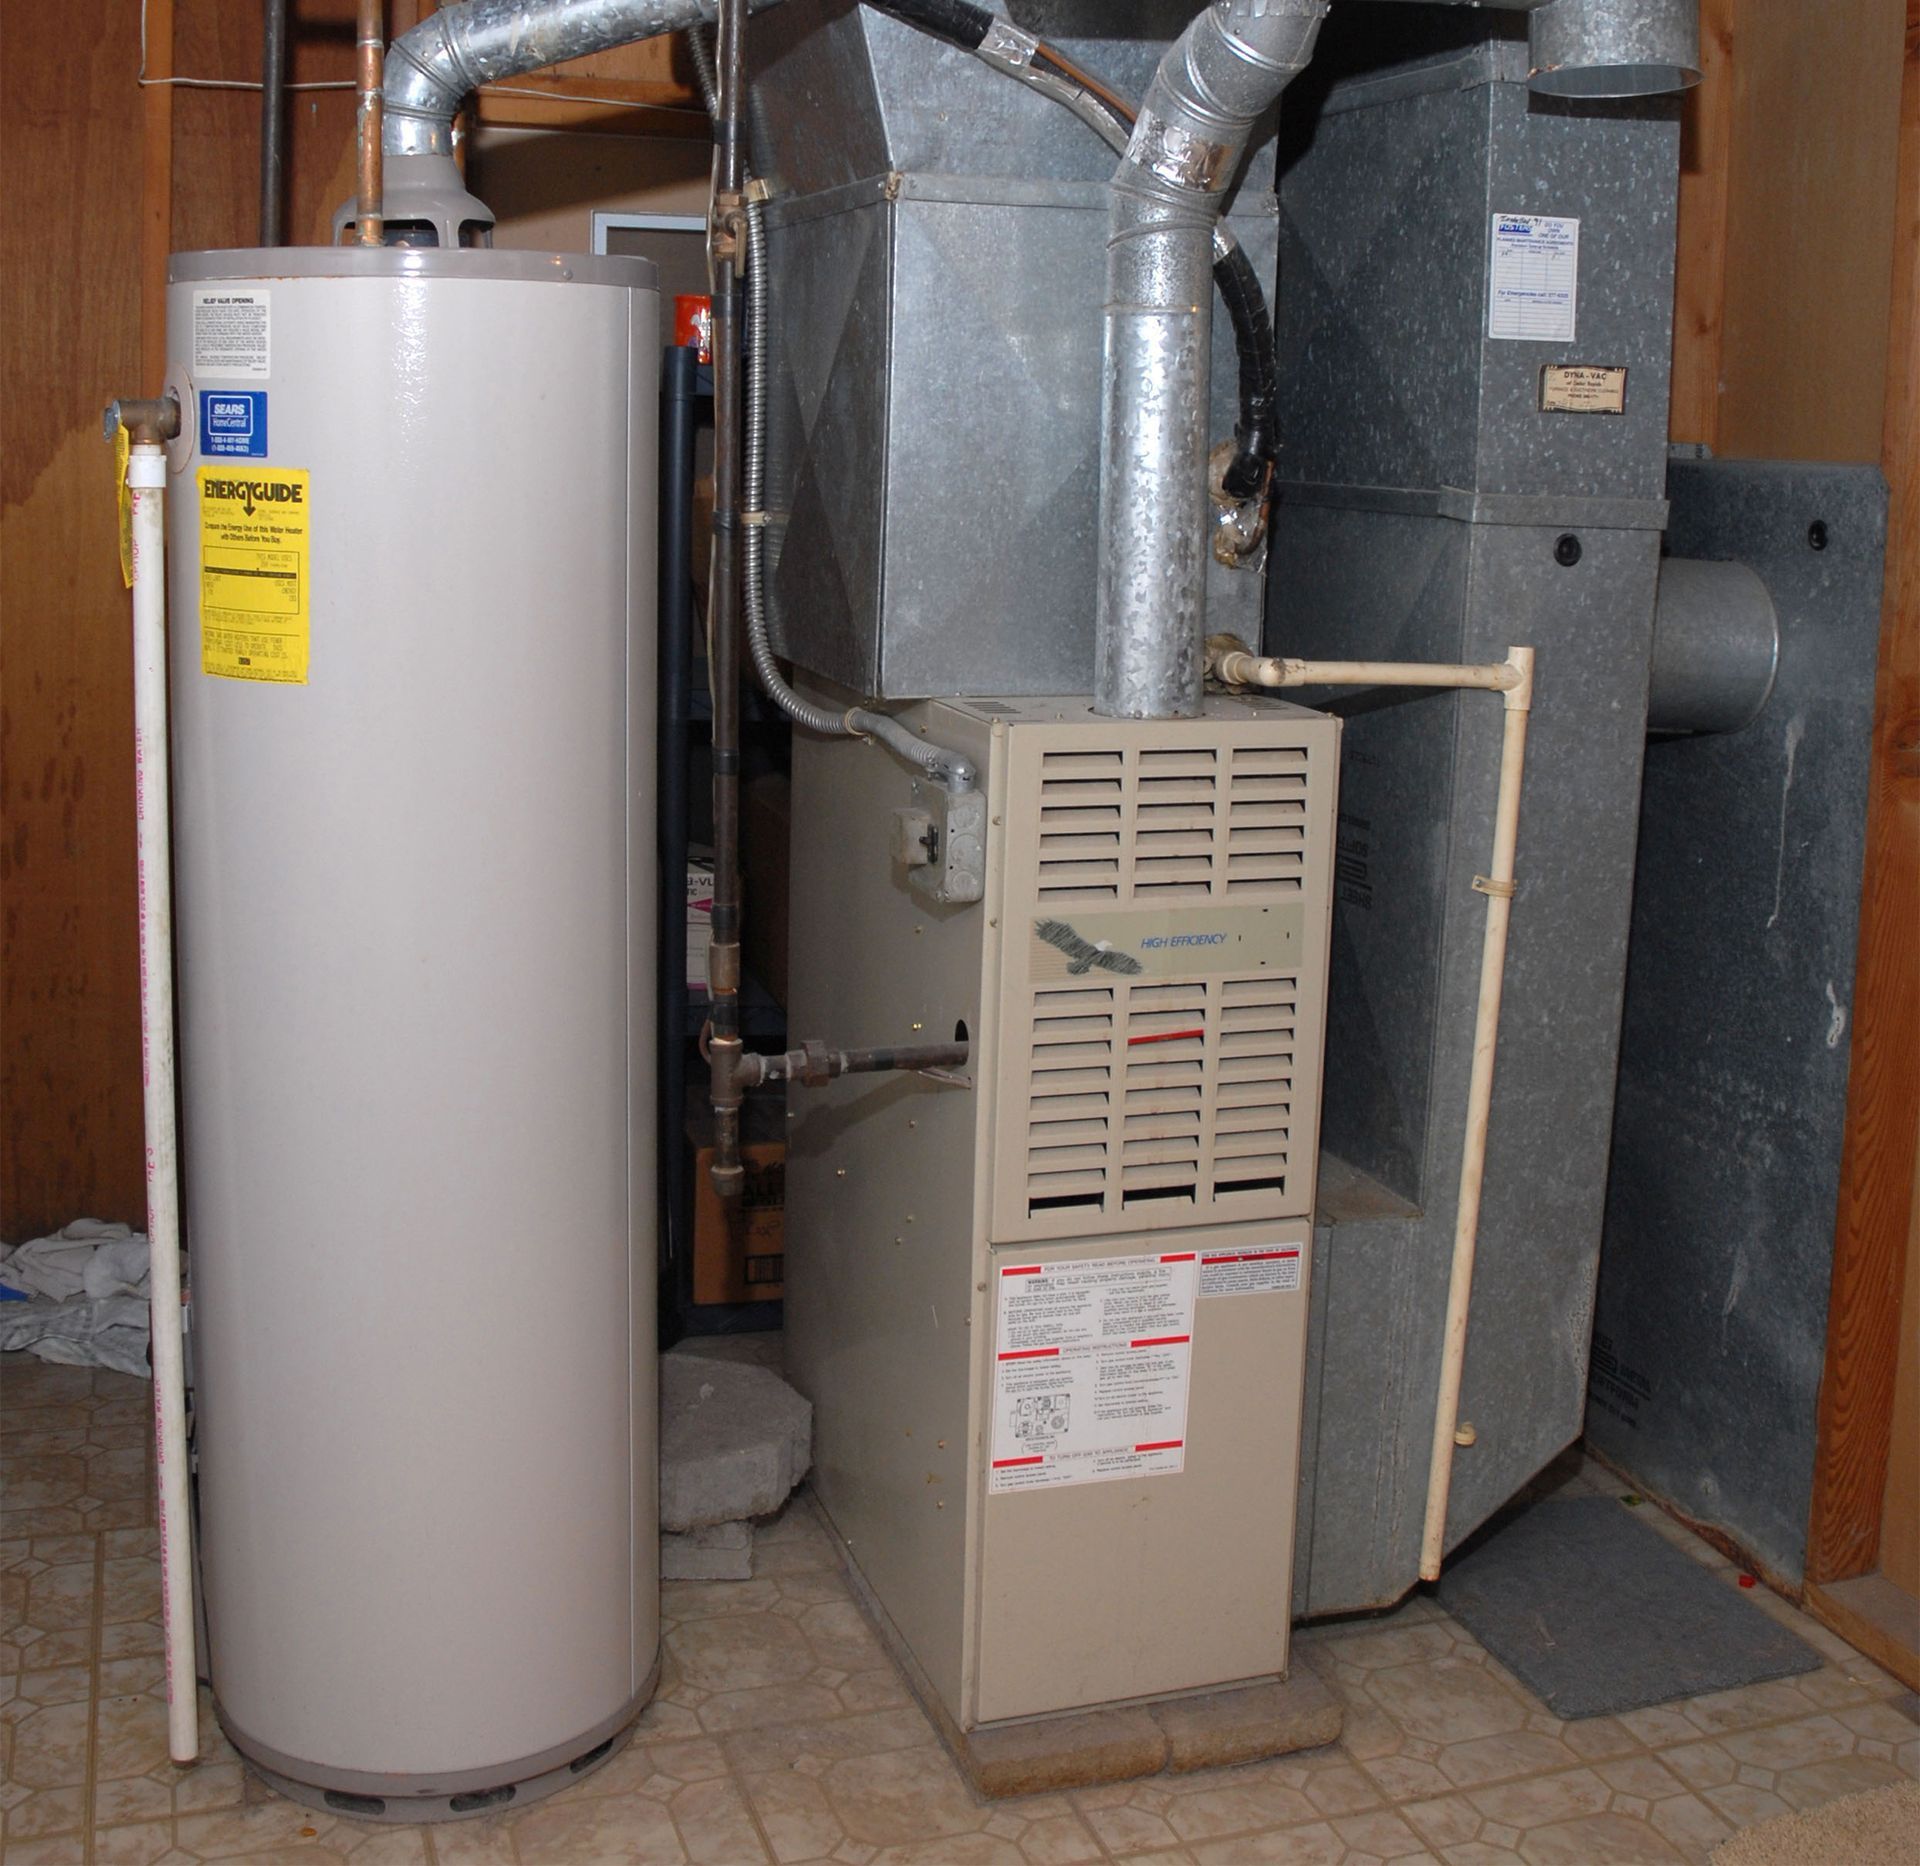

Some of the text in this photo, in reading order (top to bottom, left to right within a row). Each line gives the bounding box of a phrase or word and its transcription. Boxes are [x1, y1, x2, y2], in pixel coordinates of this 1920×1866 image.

[214, 404, 245, 415] SEARS
[204, 479, 303, 504] ENERGYGUIDE
[1140, 933, 1227, 948] HIGH EFFICIENCY
